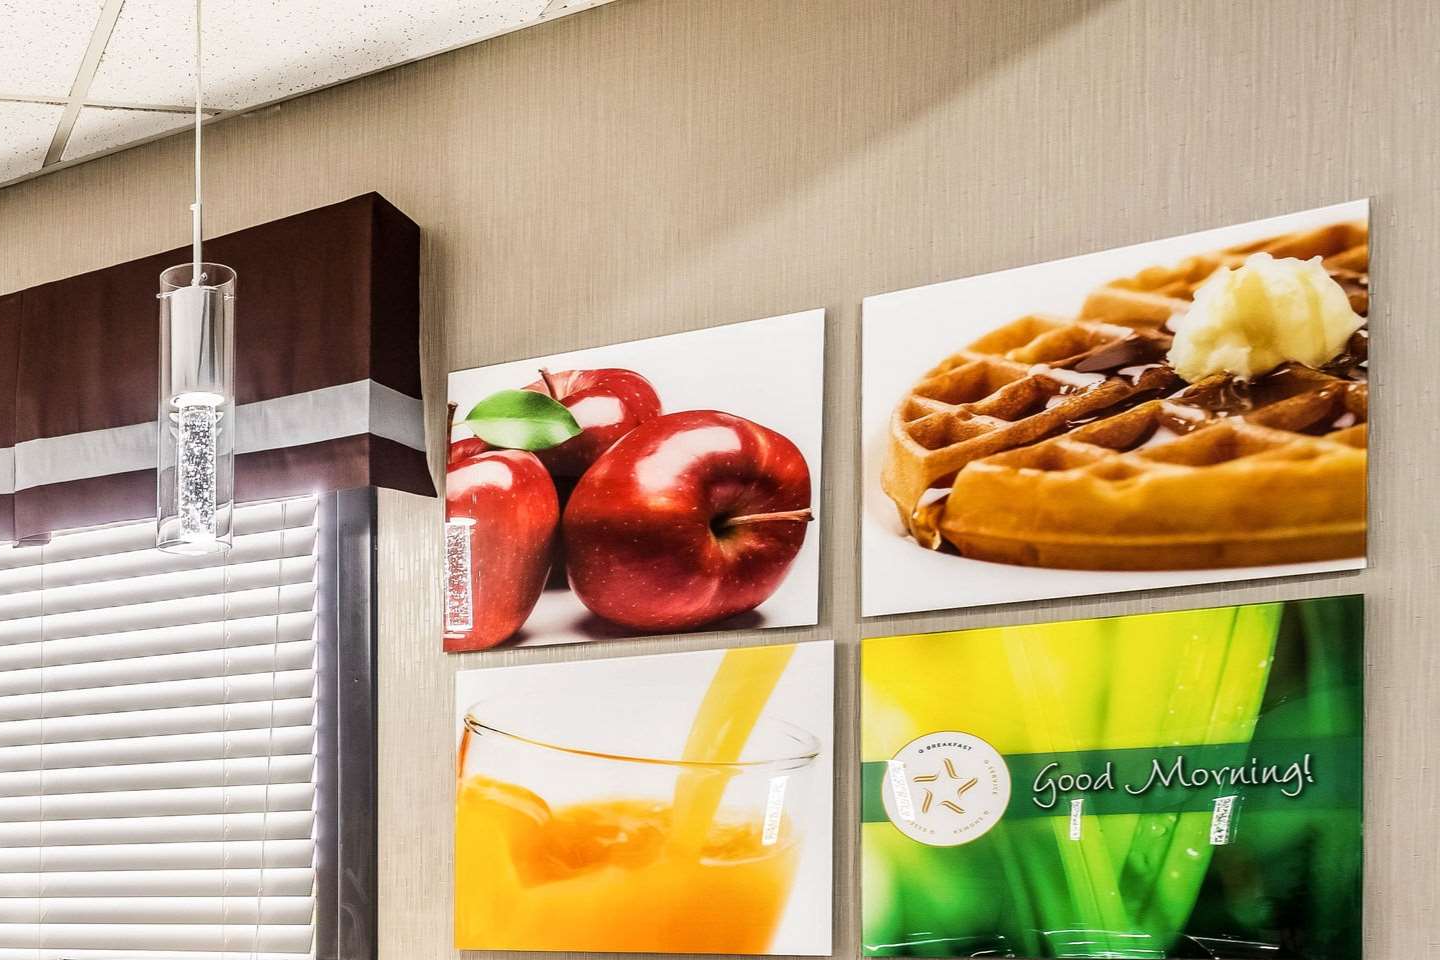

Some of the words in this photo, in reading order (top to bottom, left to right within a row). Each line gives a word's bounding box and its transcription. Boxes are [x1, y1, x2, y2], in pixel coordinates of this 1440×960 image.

[926, 742, 972, 751] BREAKFAST
[1032, 762, 1114, 809] Good
[1125, 753, 1314, 797] Morning!
